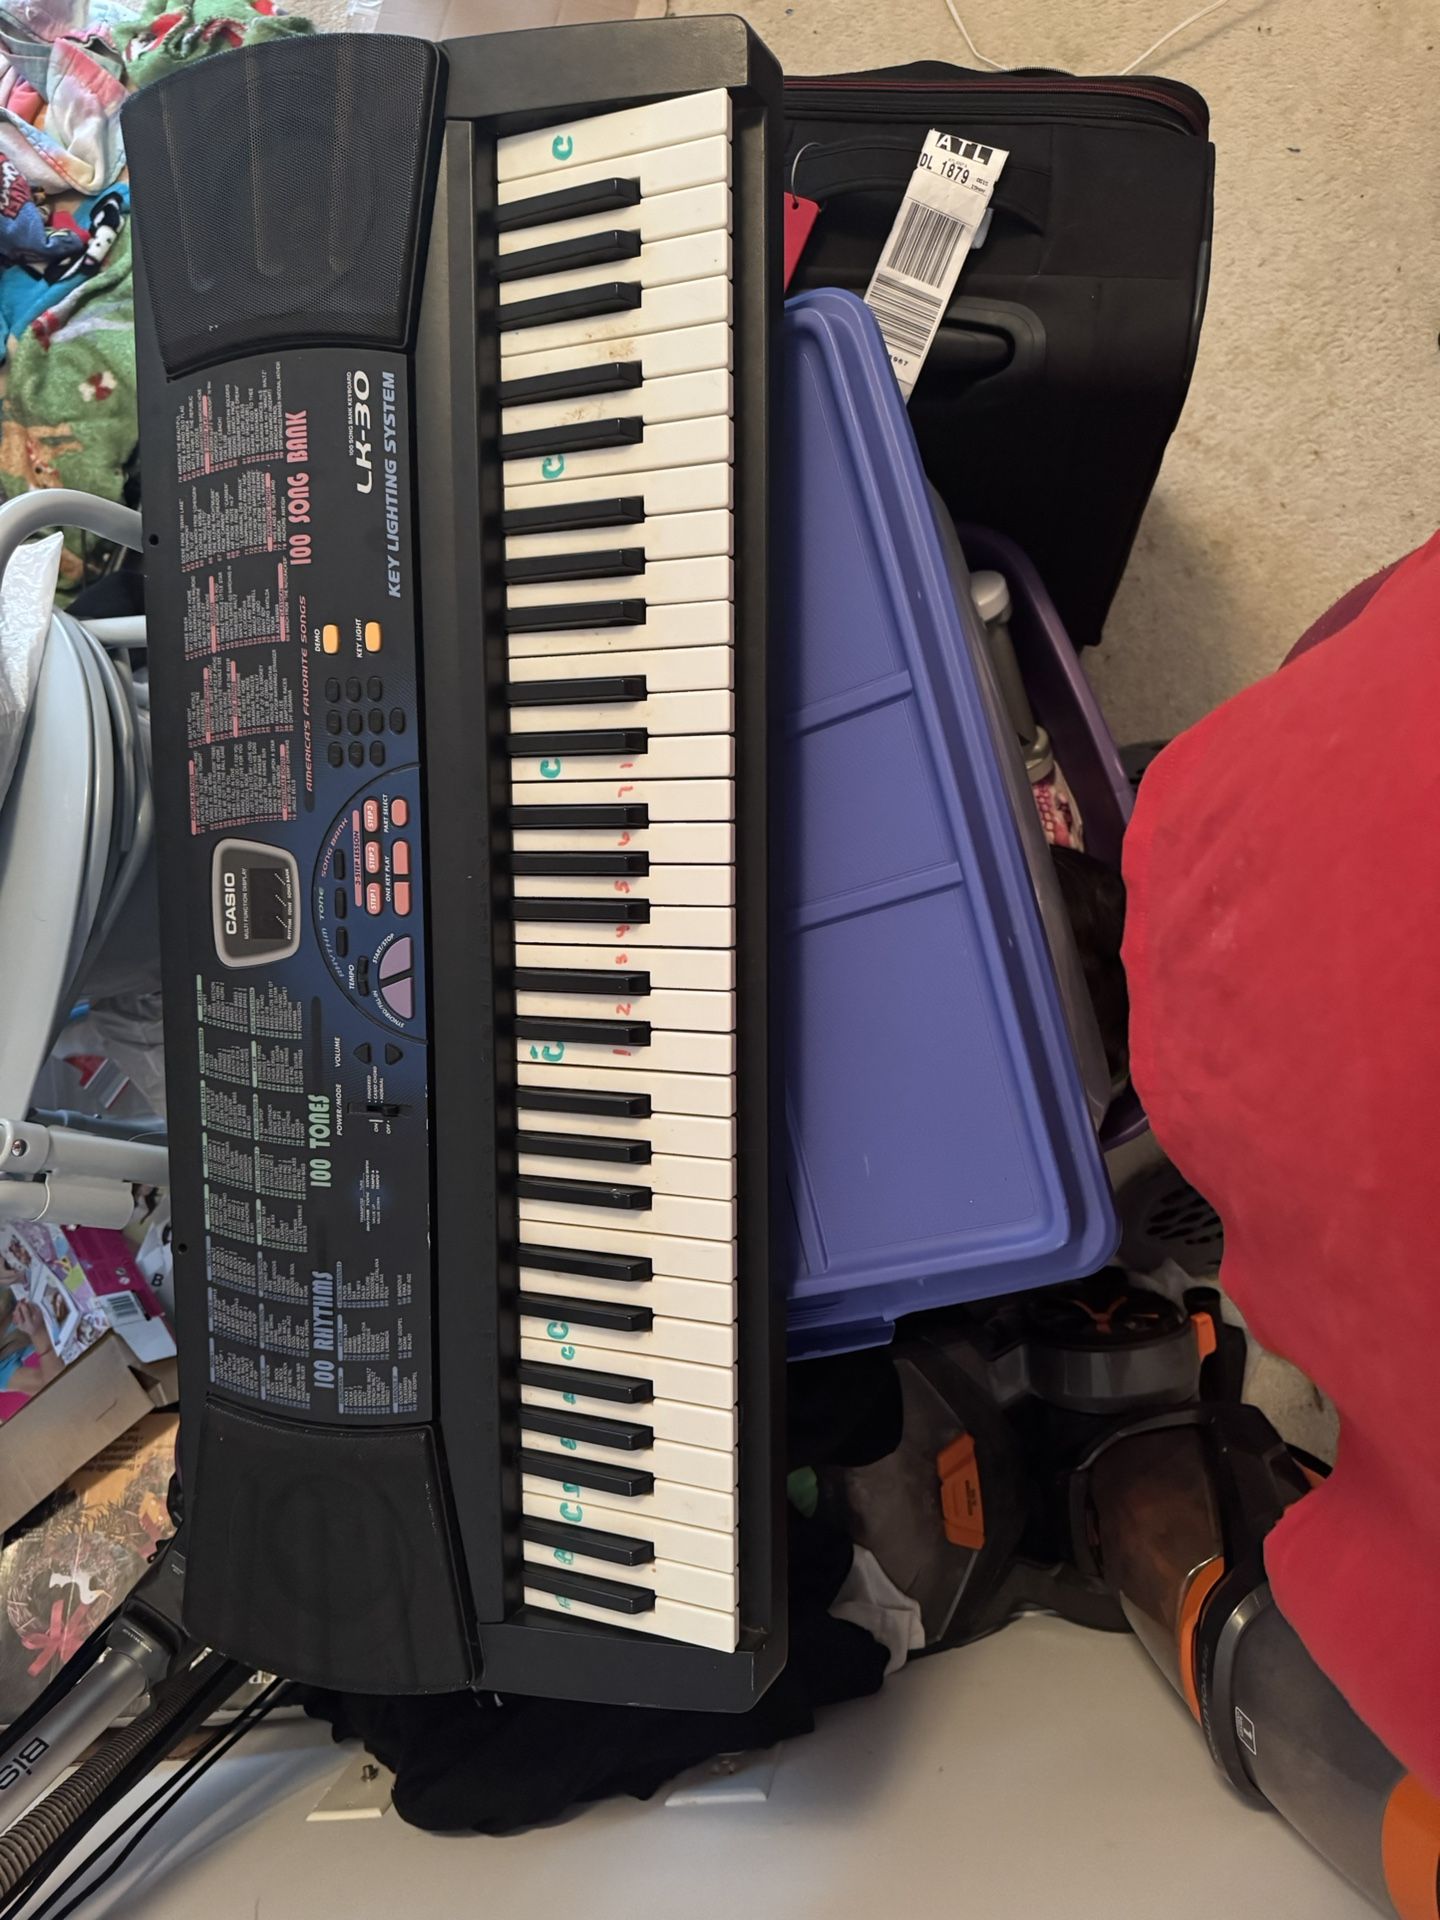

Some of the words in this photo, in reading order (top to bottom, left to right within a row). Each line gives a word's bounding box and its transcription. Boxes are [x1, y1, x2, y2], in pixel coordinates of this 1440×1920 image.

[552, 135, 574, 161] C
[936, 132, 986, 165] ATL
[919, 152, 933, 170] DL
[940, 160, 970, 184] 1879
[382, 372, 397, 453] SYSTEM
[285, 410, 308, 462] BANK
[354, 370, 372, 494] LK-30
[541, 455, 565, 479] C
[287, 473, 311, 523] SONG
[384, 459, 399, 552] LIGHTING
[289, 534, 312, 565] 100
[387, 555, 400, 597] KEY
[299, 595, 308, 643] SONGS
[301, 648, 310, 716] FAVORITE
[304, 720, 313, 792] AMERICA'S
[539, 758, 561, 779] C
[321, 847, 333, 877] SONG
[614, 880, 630, 894] 5
[224, 873, 236, 934] CASIO
[616, 924, 630, 938] 4
[372, 933, 395, 963] START/STOP
[616, 1003, 631, 1015] 2
[308, 1094, 330, 1149] TONES
[374, 1123, 379, 1132] ON
[310, 1159, 332, 1188] 100
[312, 1271, 334, 1350] RHYTHMS
[547, 1321, 569, 1340] C
[314, 1360, 335, 1388] 100
[559, 1502, 583, 1522] C
